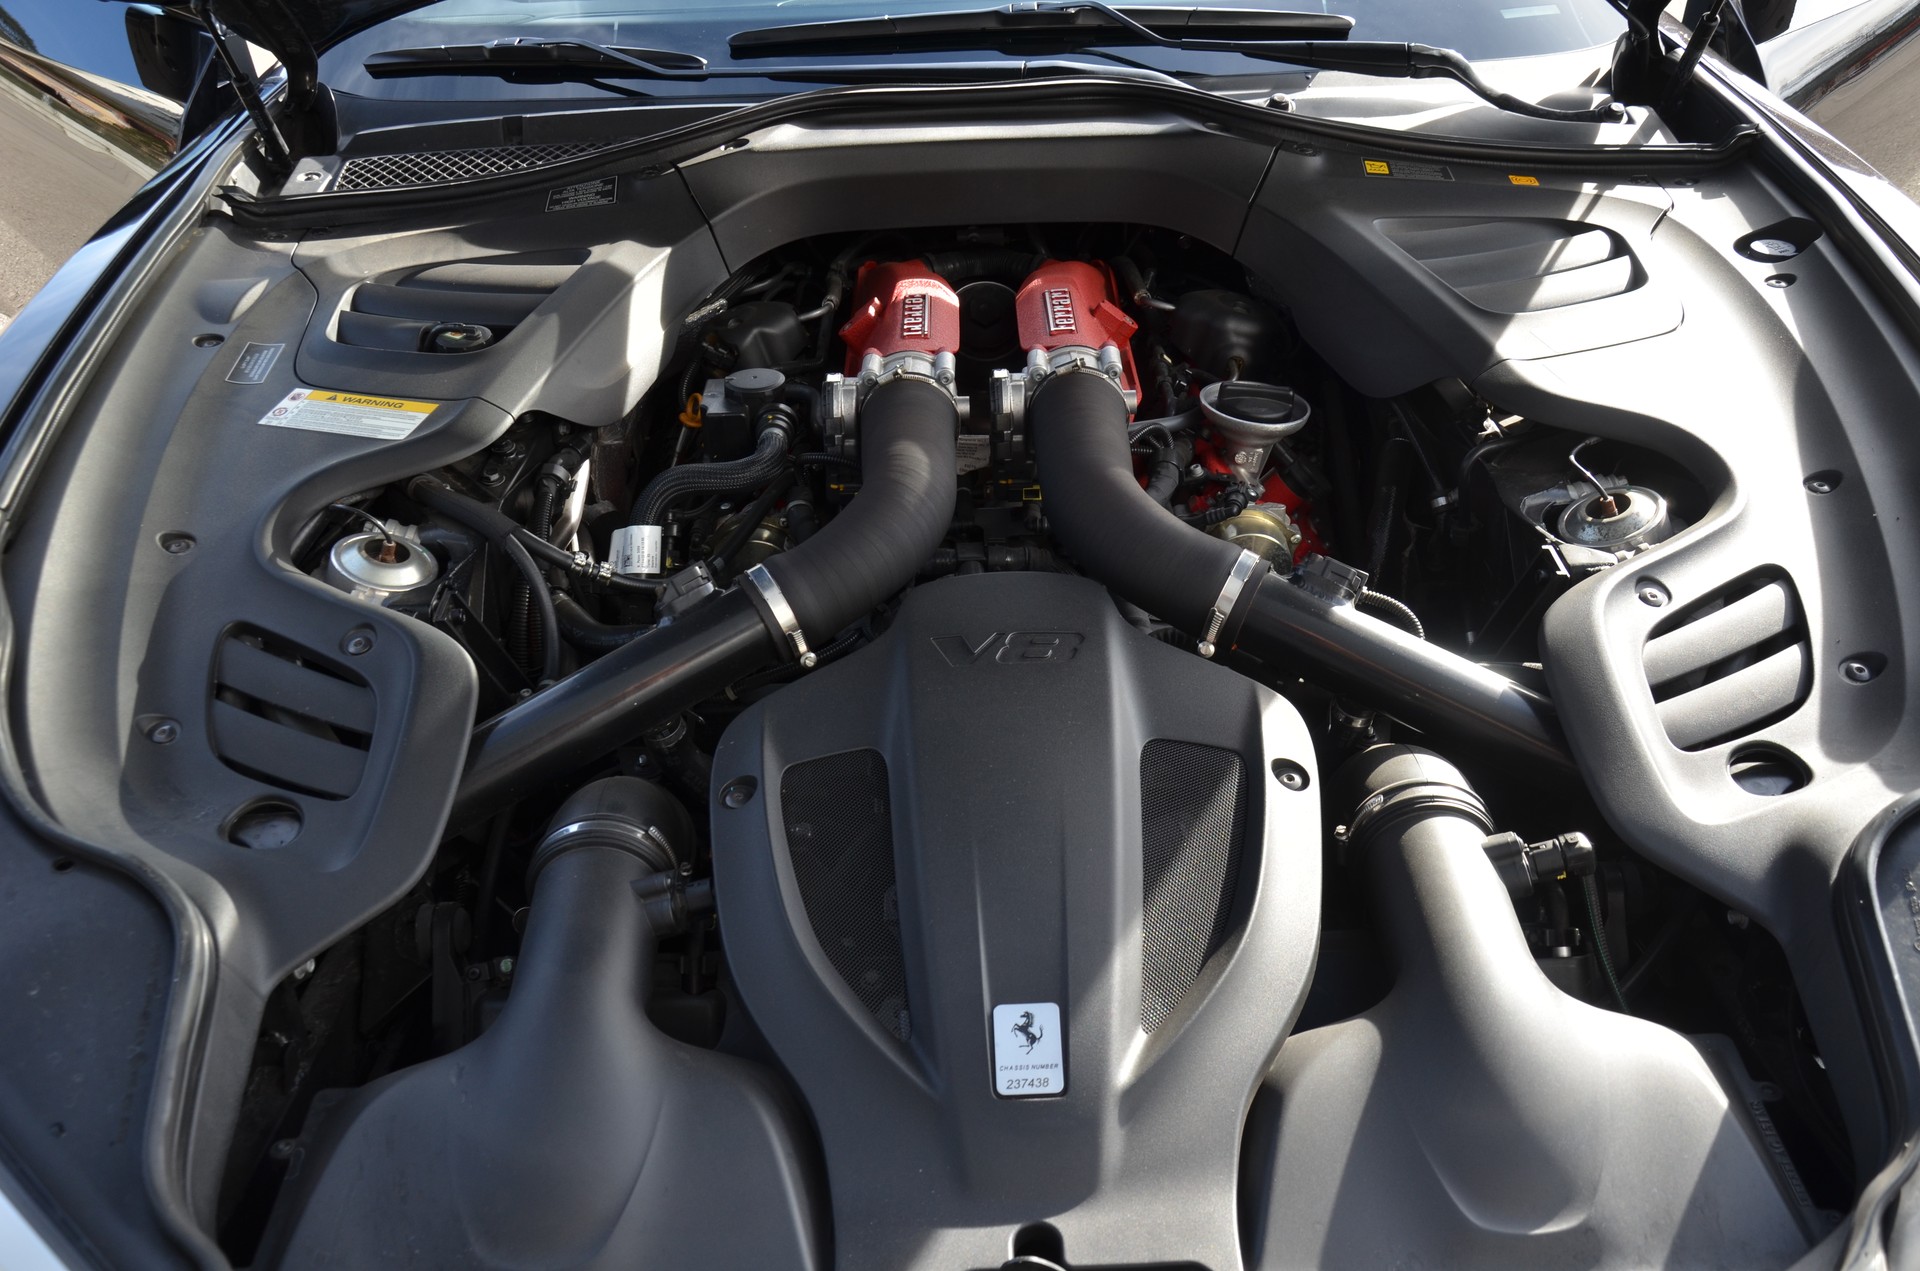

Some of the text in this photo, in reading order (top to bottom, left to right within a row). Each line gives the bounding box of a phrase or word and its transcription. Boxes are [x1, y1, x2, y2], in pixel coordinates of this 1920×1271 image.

[1044, 287, 1076, 331] Ferrari
[342, 396, 405, 409] WARNING
[930, 631, 1086, 667] V8
[999, 1064, 1030, 1072] CHASSIS
[1006, 1077, 1050, 1090] 237438
